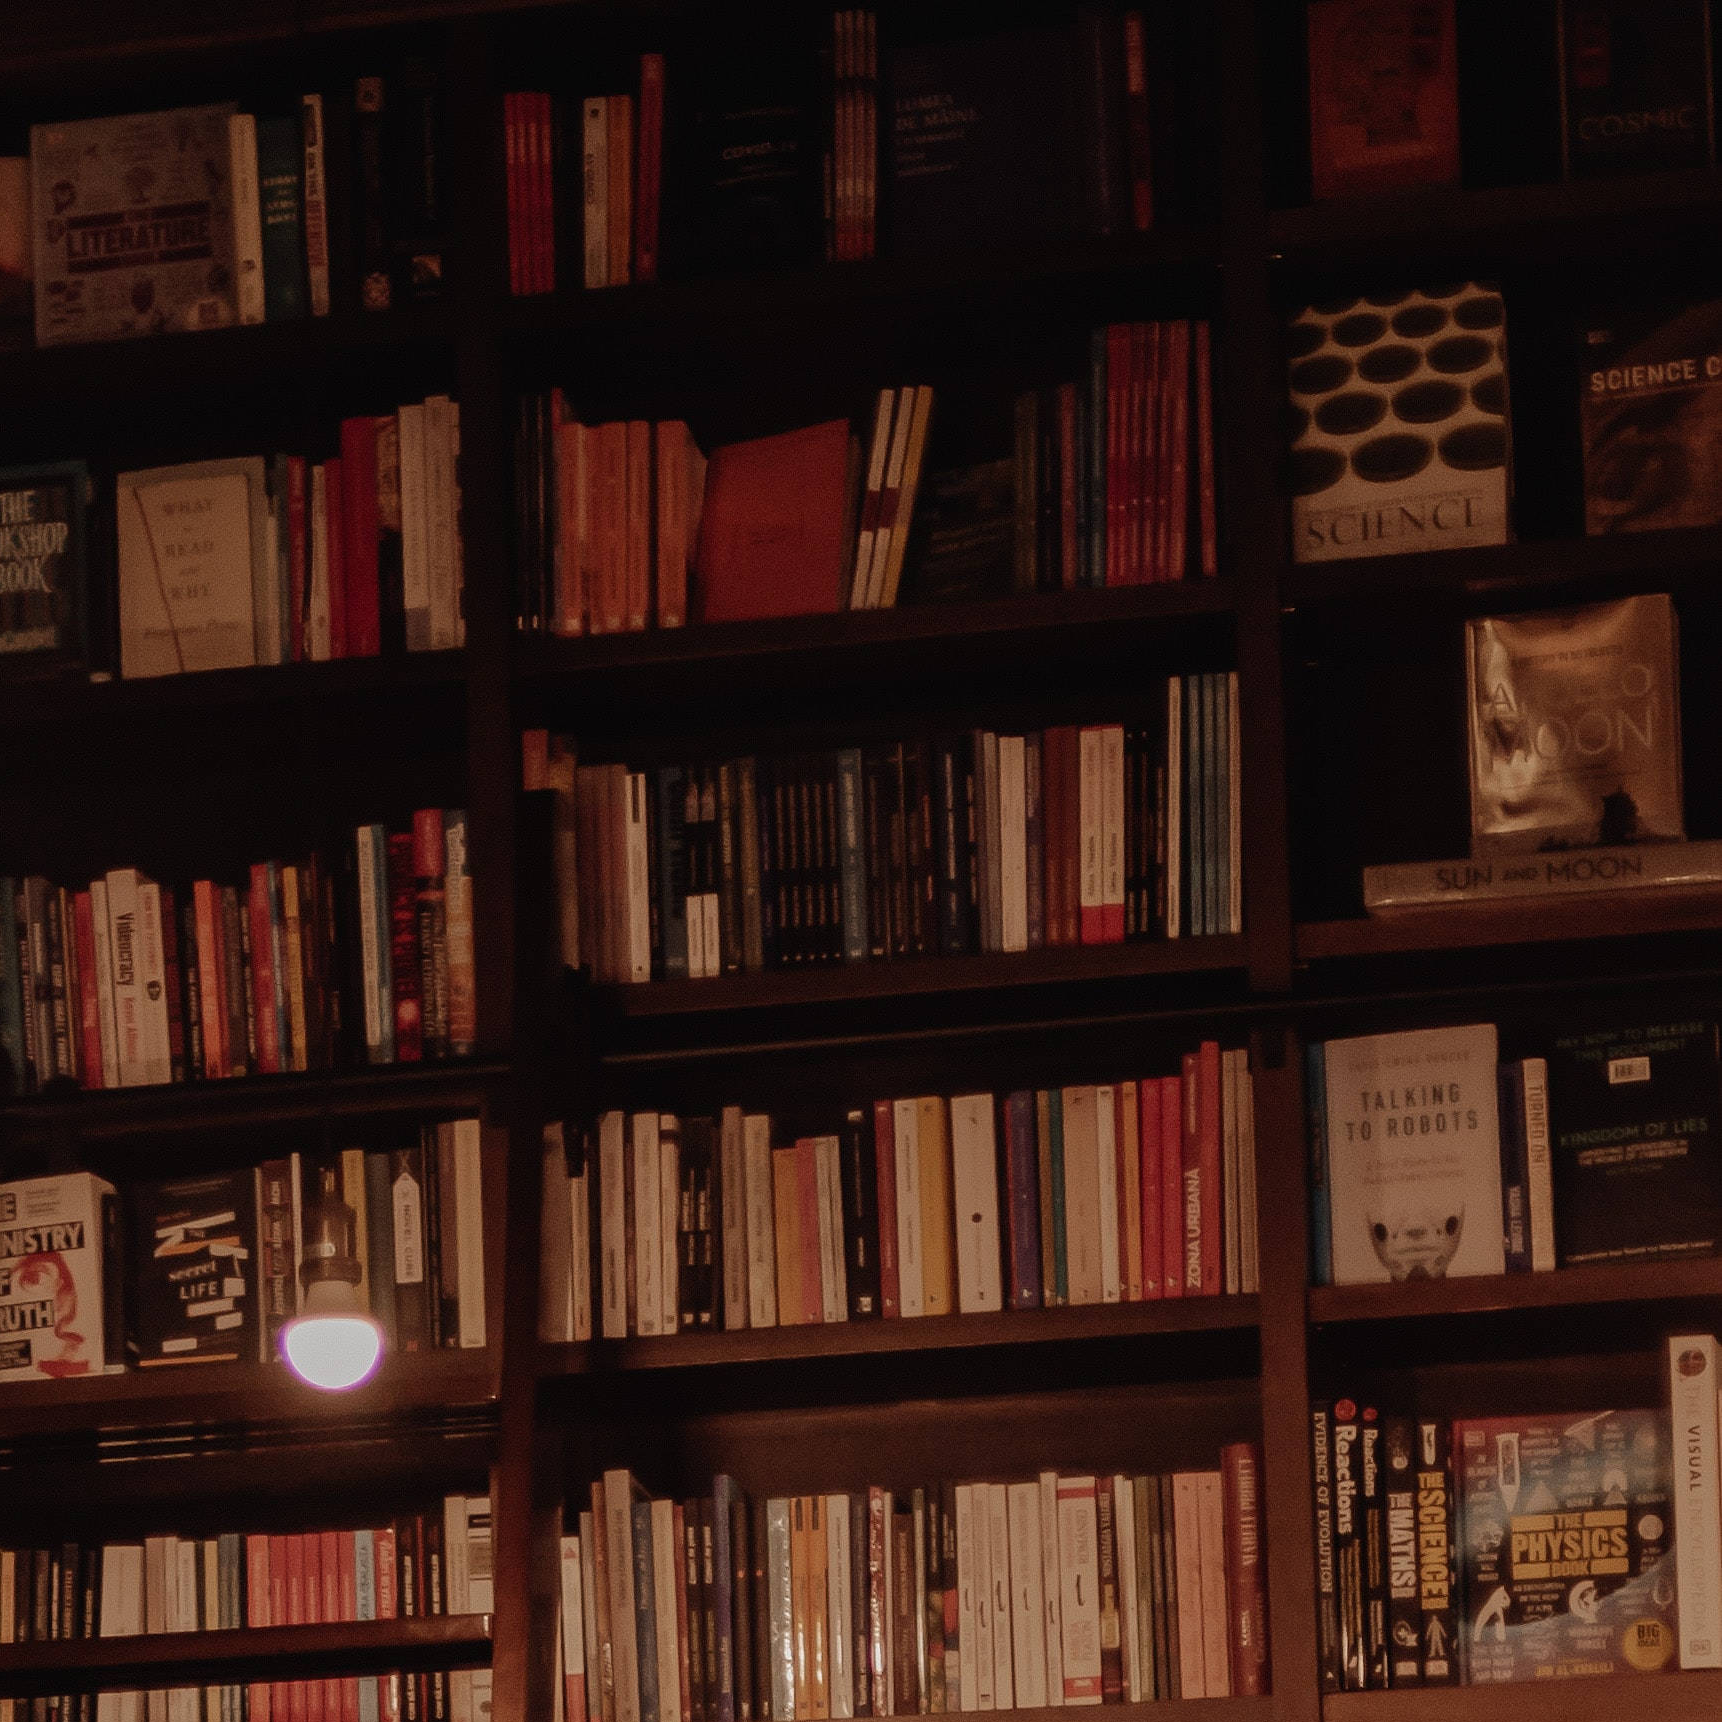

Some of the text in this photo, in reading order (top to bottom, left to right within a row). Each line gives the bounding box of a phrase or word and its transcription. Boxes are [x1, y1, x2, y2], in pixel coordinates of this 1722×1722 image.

[1579, 106, 1696, 139] COSMIC
[66, 216, 212, 260] LITERATURE
[1590, 358, 1696, 392] SCIENCE
[1307, 497, 1483, 550] SCIENCE
[1436, 856, 1642, 892] SUN AND MOON
[116, 913, 135, 986] Videocracy
[1361, 1082, 1461, 1113] TALKING
[1345, 1109, 1478, 1142] TO ROBOTS
[1528, 1085, 1546, 1163] TURNED ON
[1559, 1117, 1709, 1148] KINGDOM OF LIES
[168, 1260, 217, 1282] secret
[1186, 1240, 1202, 1288] ZONA
[179, 1281, 218, 1301] LIFE
[1363, 1428, 1379, 1498] Reactions
[1687, 1425, 1703, 1492] VISUAL
[1335, 1424, 1357, 1535] Reactions
[1313, 1412, 1333, 1593] EVIDENCE OF EVOLUTION
[1555, 1513, 1582, 1530] THE
[1388, 1509, 1416, 1587] MATHS
[1417, 1489, 1449, 1598] SCIENCE
[1512, 1526, 1628, 1563] PHYSICS
[1550, 1560, 1590, 1577] BOOK
[1688, 1499, 1706, 1633] ENCYCLOPEDIA
[1637, 1624, 1660, 1638] BIG
